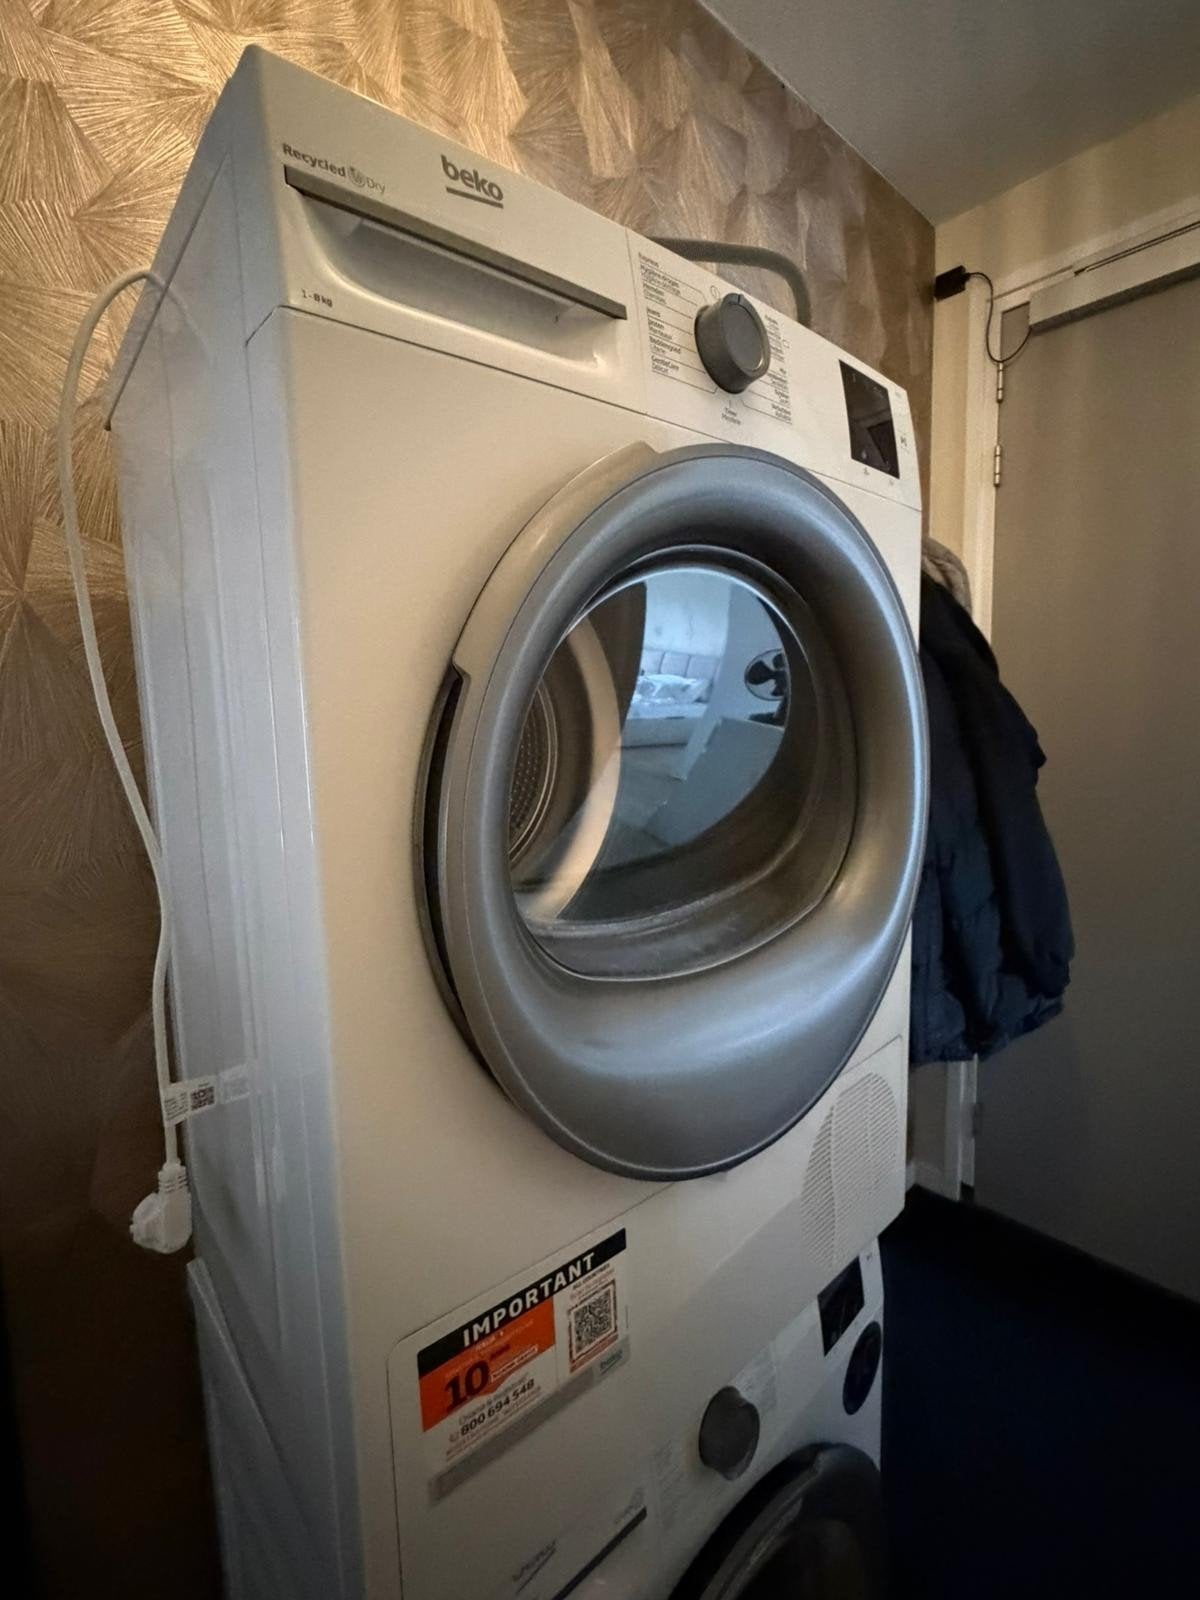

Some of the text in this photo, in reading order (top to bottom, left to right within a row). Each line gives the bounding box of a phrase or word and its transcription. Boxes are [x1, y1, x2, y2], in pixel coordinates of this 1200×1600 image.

[282, 143, 386, 195] Recycled Dry
[440, 154, 504, 201] beko
[462, 1252, 595, 1348] IMPORTANT
[444, 1361, 490, 1413] 10
[488, 1395, 510, 1417] 694
